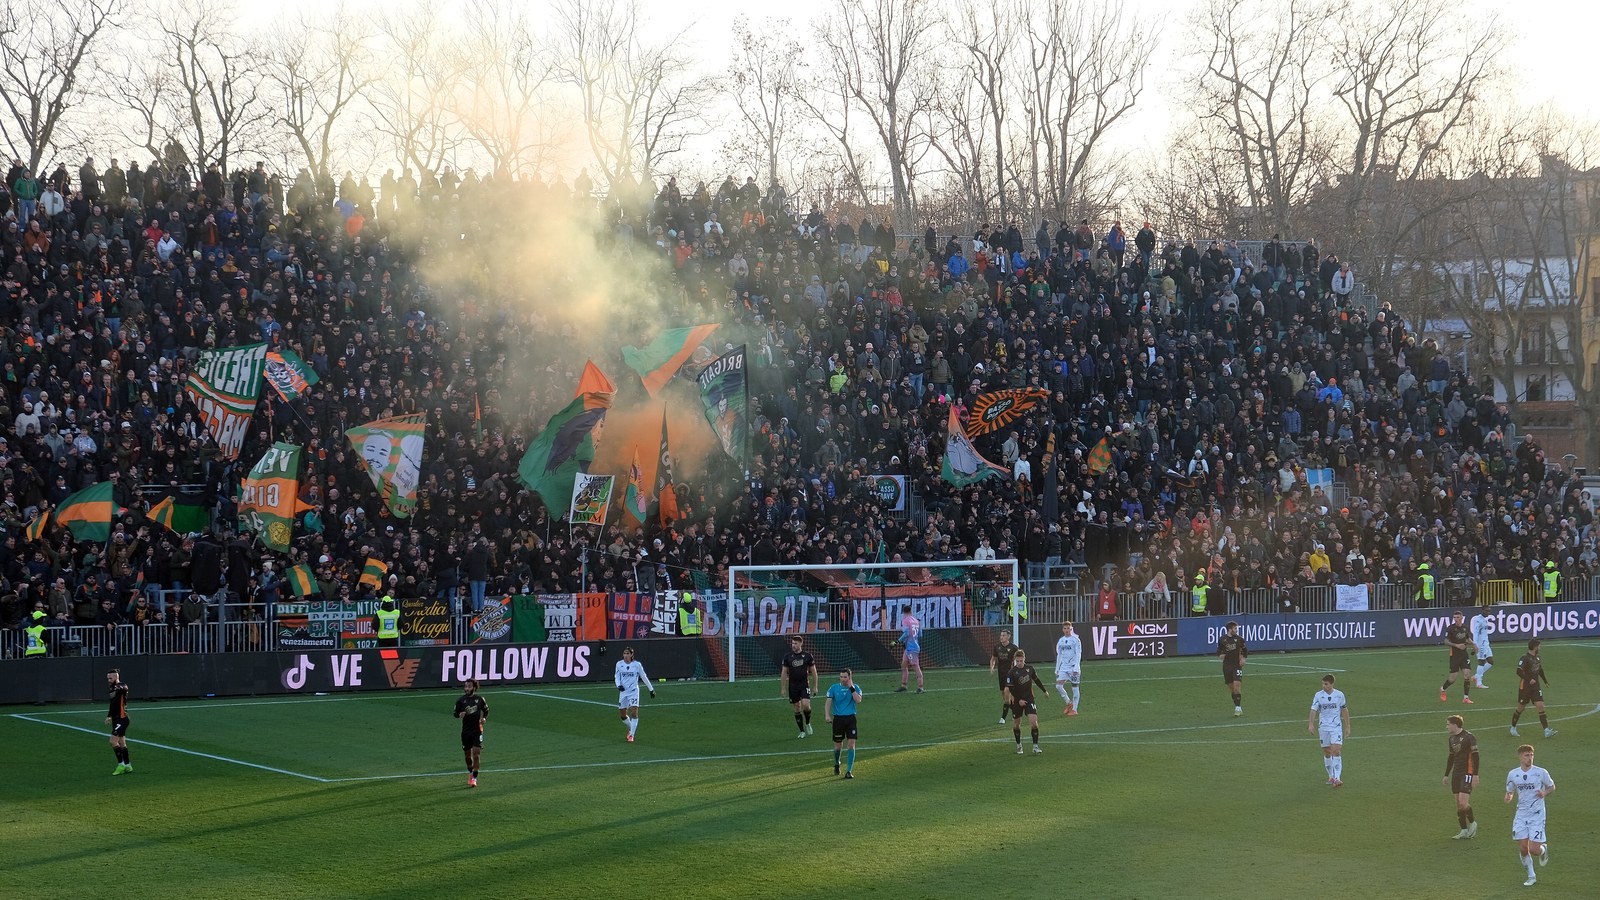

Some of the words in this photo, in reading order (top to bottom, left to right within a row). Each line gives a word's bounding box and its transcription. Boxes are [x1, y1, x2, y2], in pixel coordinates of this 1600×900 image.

[879, 485, 895, 493] ASSO
[613, 612, 648, 622] PISTOIA
[702, 595, 828, 637] BRIGATE
[852, 596, 963, 631] VETERANI
[1133, 623, 1168, 635] NGM
[1207, 623, 1312, 645] BIOTIMOLATORE
[1314, 621, 1376, 640] TISSUTALE
[280, 637, 334, 646] veneziamestre
[1092, 625, 1118, 656] VE
[1128, 641, 1165, 657] 42:13
[330, 653, 363, 687] VE
[441, 647, 549, 682] FOLLOW
[557, 645, 591, 678] US
[1464, 774, 1472, 783] 11
[1533, 830, 1543, 840] 21
